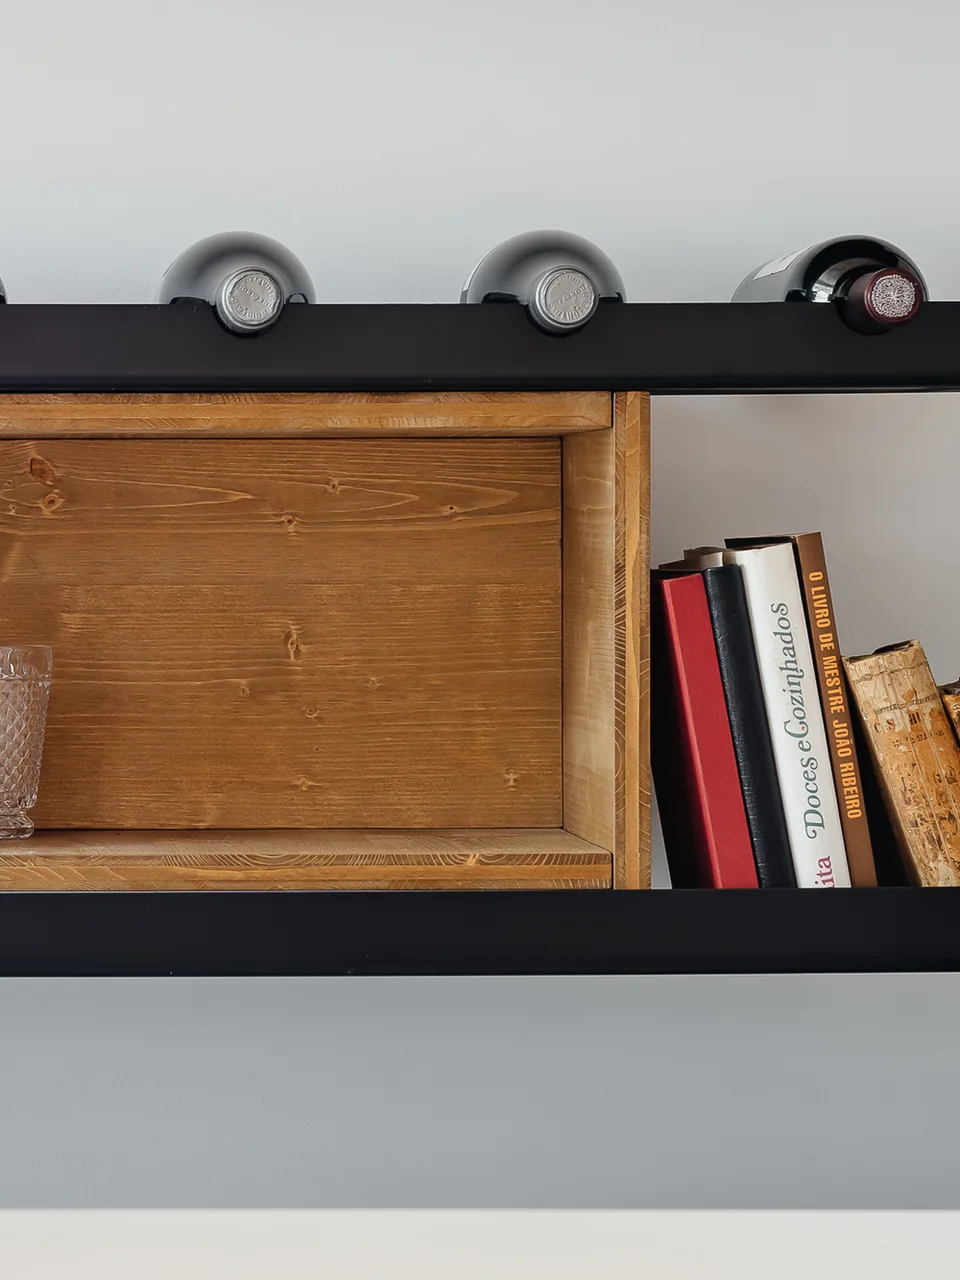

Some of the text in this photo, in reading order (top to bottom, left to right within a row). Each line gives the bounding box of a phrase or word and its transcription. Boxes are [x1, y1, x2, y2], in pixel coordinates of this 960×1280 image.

[771, 602, 826, 840] Doces e Cozinhados
[808, 571, 862, 820] O LIVRO DE MESTRE JOÃO RIBEIRO
